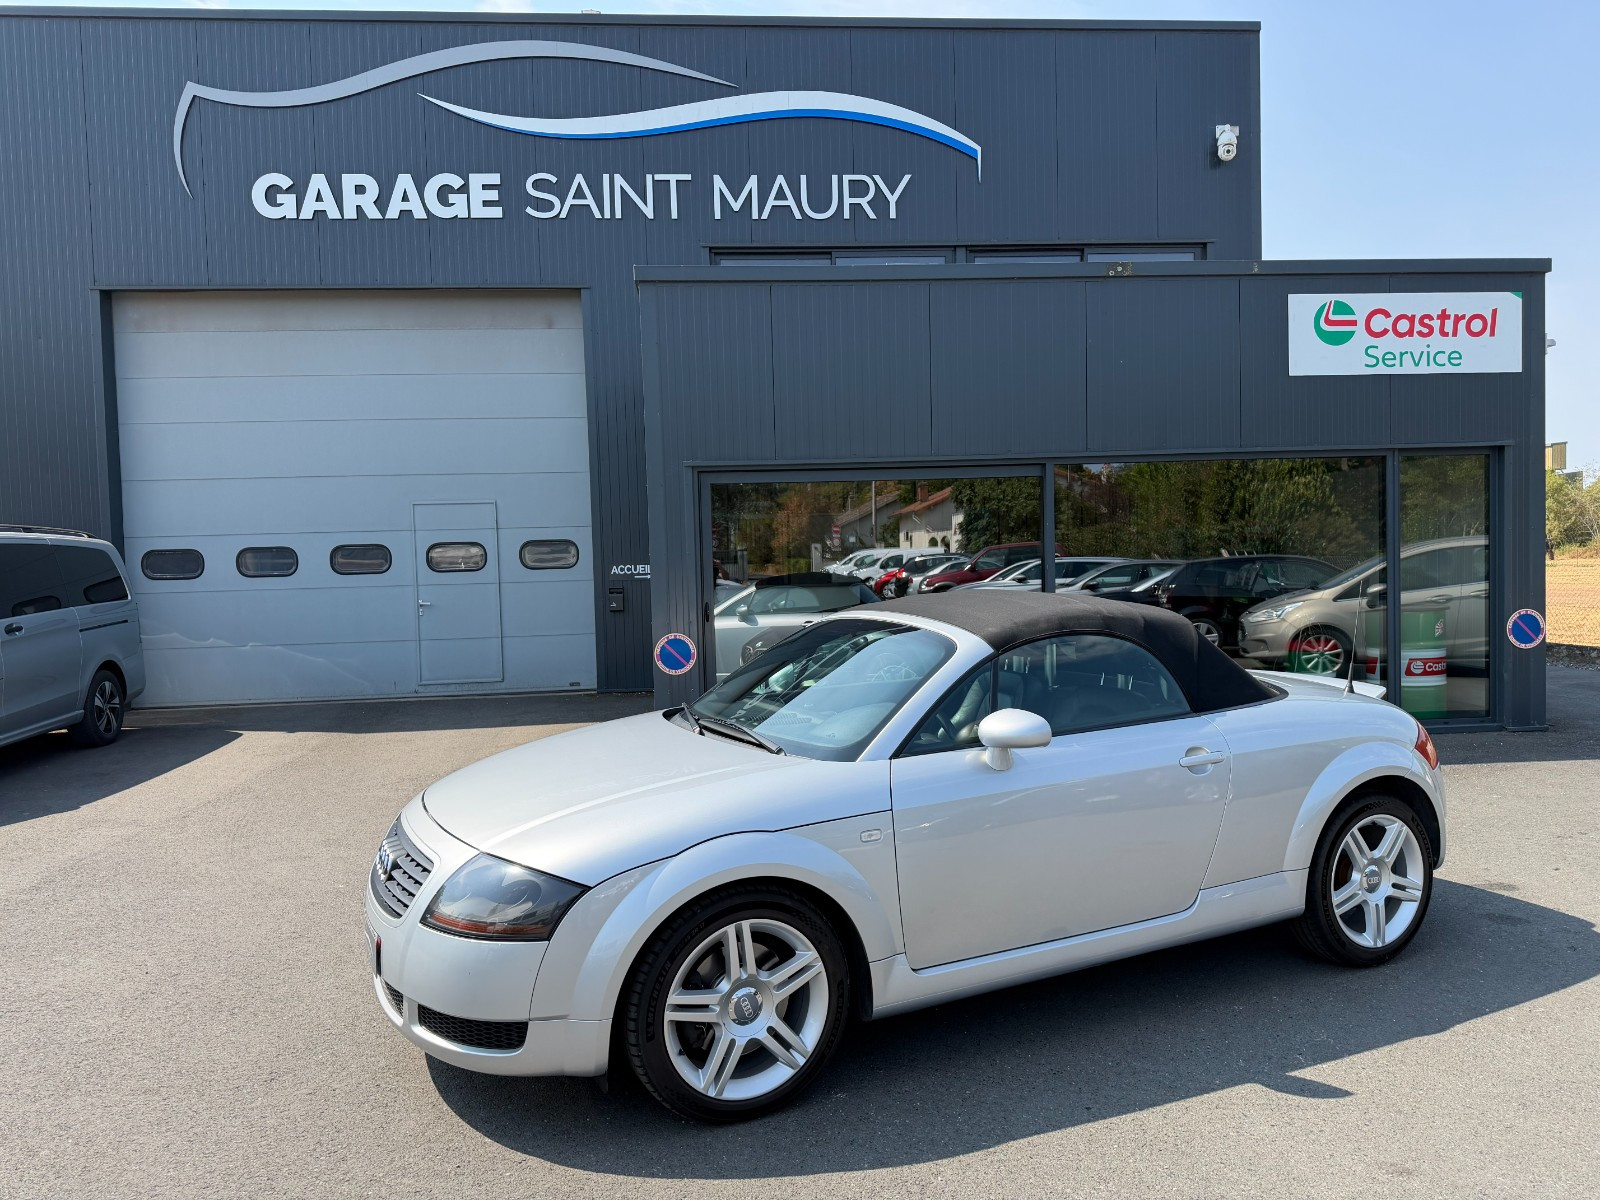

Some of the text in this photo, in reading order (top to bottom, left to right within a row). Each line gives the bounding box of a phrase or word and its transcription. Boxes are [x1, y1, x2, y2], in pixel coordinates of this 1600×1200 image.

[251, 172, 912, 220] GARAGE SAINT MAURY
[1364, 307, 1498, 339] Castrol
[1364, 343, 1463, 369] Service
[610, 564, 651, 575] ACCUEIL
[648, 961, 672, 1023] MICHELIN
